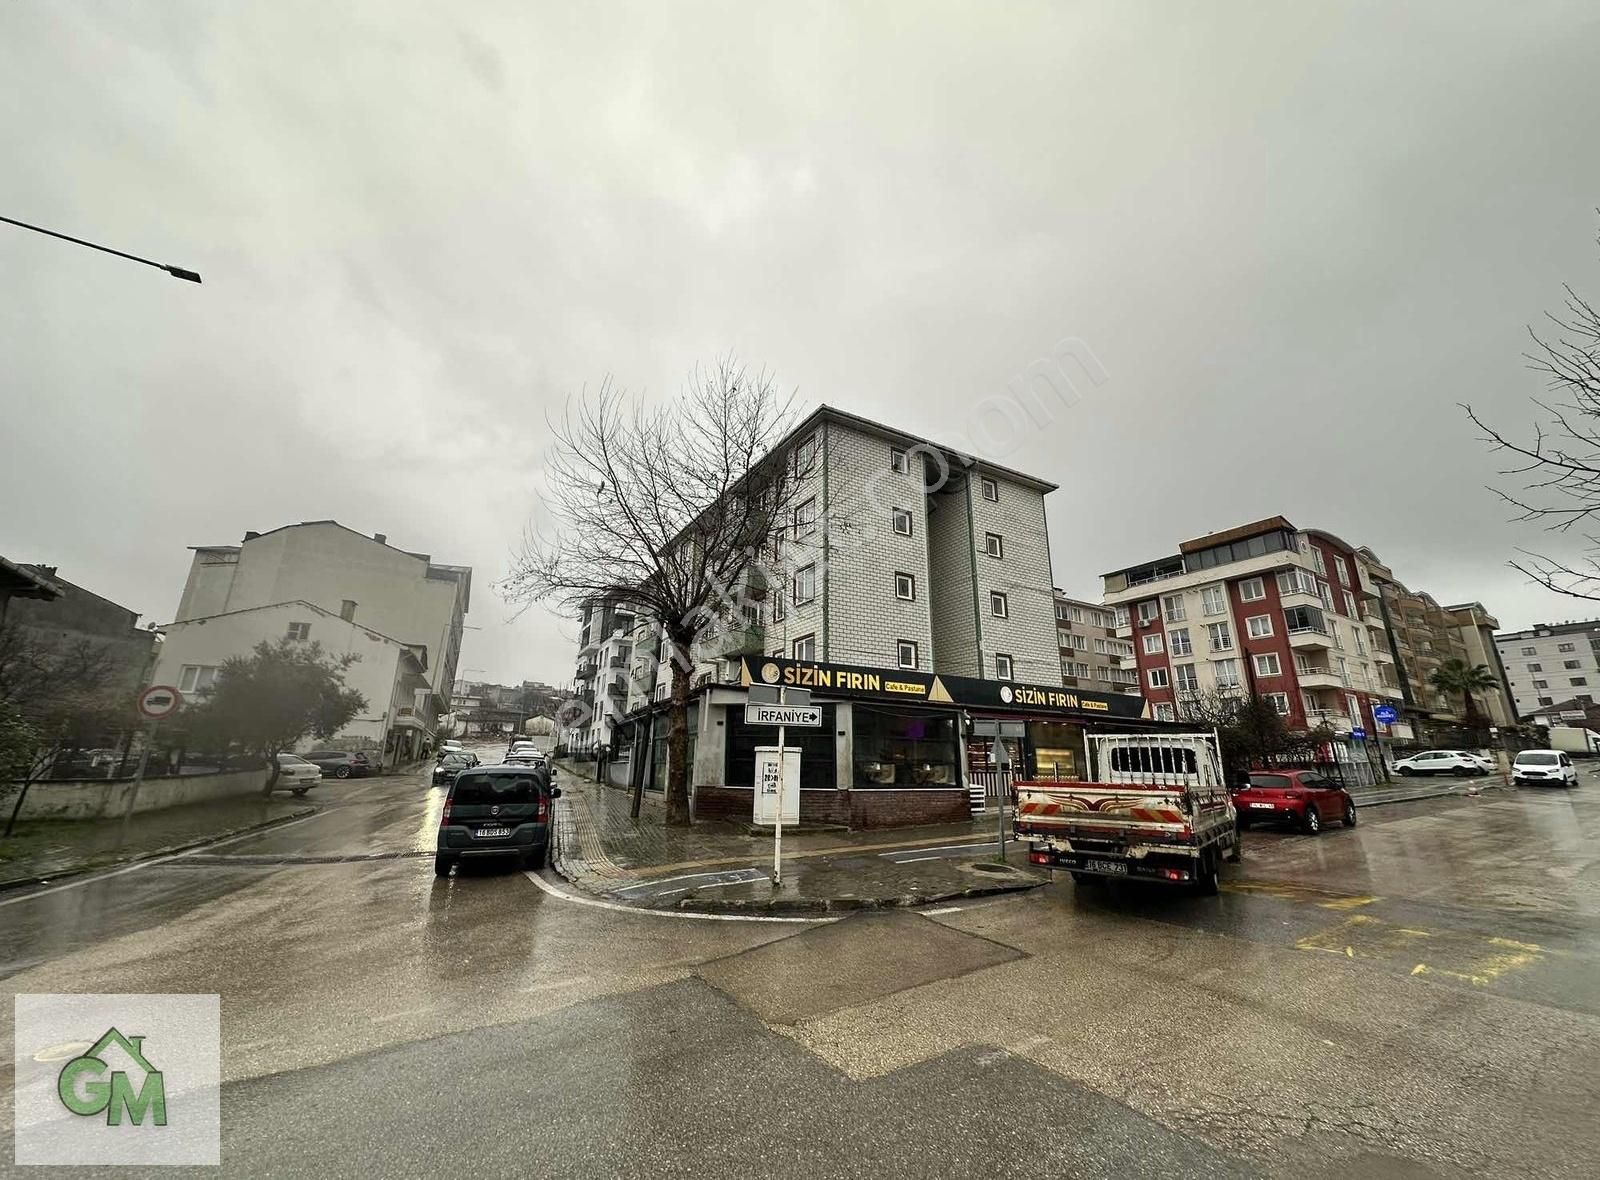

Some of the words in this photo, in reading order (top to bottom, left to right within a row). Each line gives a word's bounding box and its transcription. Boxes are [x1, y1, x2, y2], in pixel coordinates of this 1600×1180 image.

[783, 663, 831, 687] SİZİN
[837, 671, 880, 691] FIRIN
[1014, 686, 1046, 706] SİZİN
[1049, 693, 1079, 709] FIRIN
[757, 707, 810, 723] İRFANİYE
